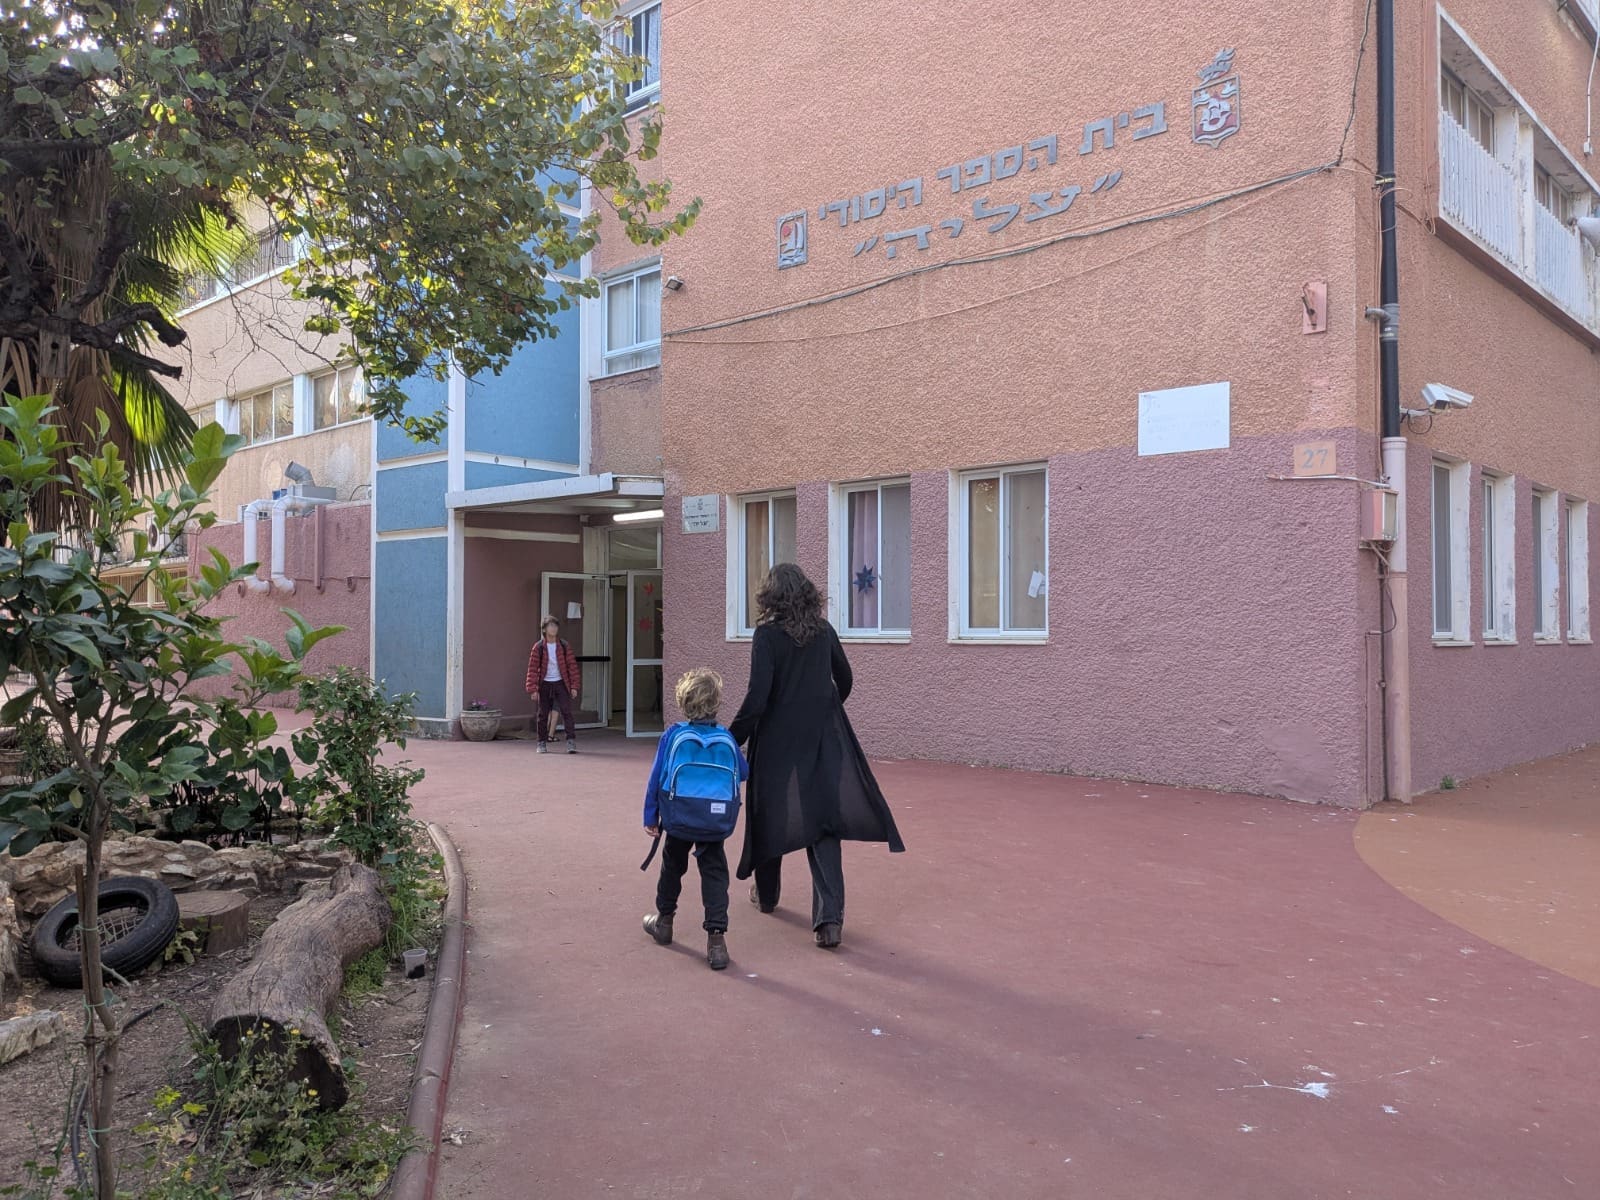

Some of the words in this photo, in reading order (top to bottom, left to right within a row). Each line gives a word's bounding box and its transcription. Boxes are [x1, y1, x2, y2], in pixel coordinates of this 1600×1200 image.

[1079, 102, 1168, 155] בית
[937, 134, 1058, 193] הספר
[819, 176, 923, 227] היסודי
[1302, 448, 1329, 469] 27
